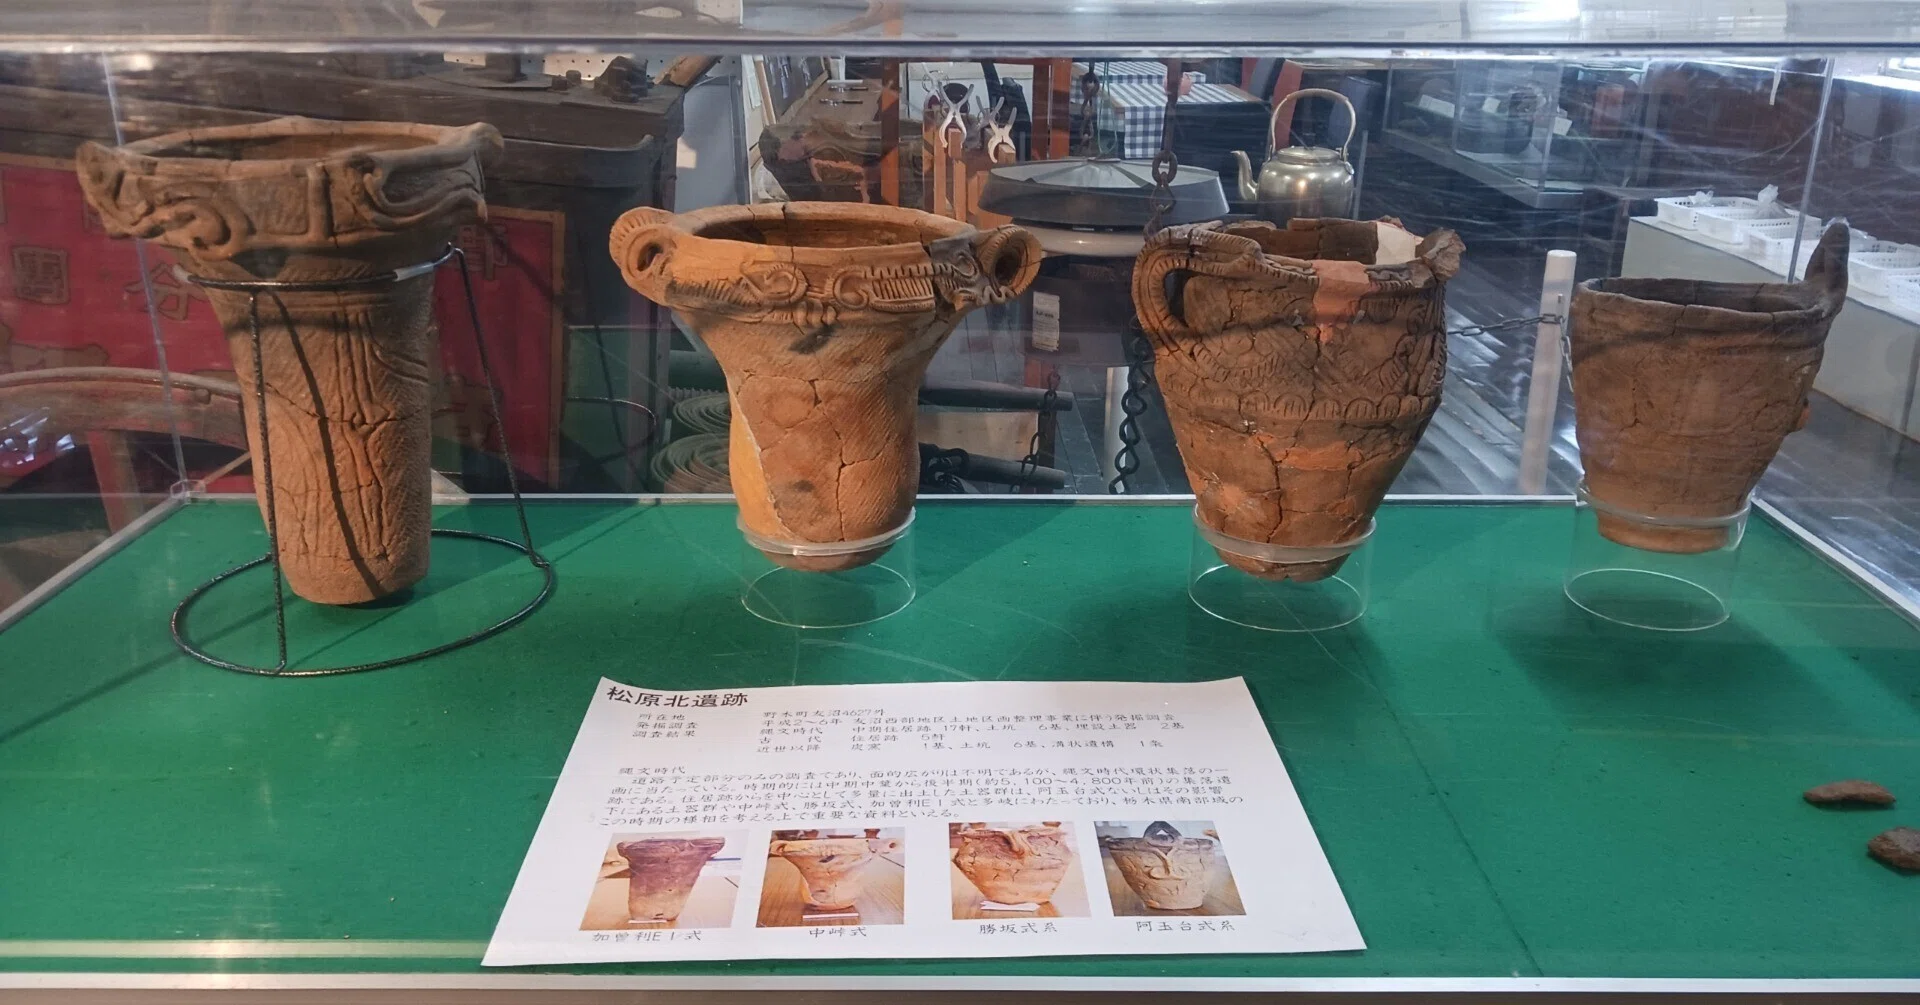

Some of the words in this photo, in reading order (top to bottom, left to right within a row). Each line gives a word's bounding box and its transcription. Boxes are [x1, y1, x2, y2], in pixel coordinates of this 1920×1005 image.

[606, 686, 750, 708] 松原北遺跡
[639, 712, 686, 721] 所在地
[636, 721, 699, 730] 発掘調査
[632, 730, 697, 738] 調査結果
[759, 727, 823, 735] 縄文時代
[756, 744, 821, 753] 近世以降
[618, 766, 686, 775] 縄文時代
[979, 921, 1060, 935] 勝坂式系
[1136, 919, 1237, 933] 阿玉台式系
[809, 926, 867, 939] 中峠式
